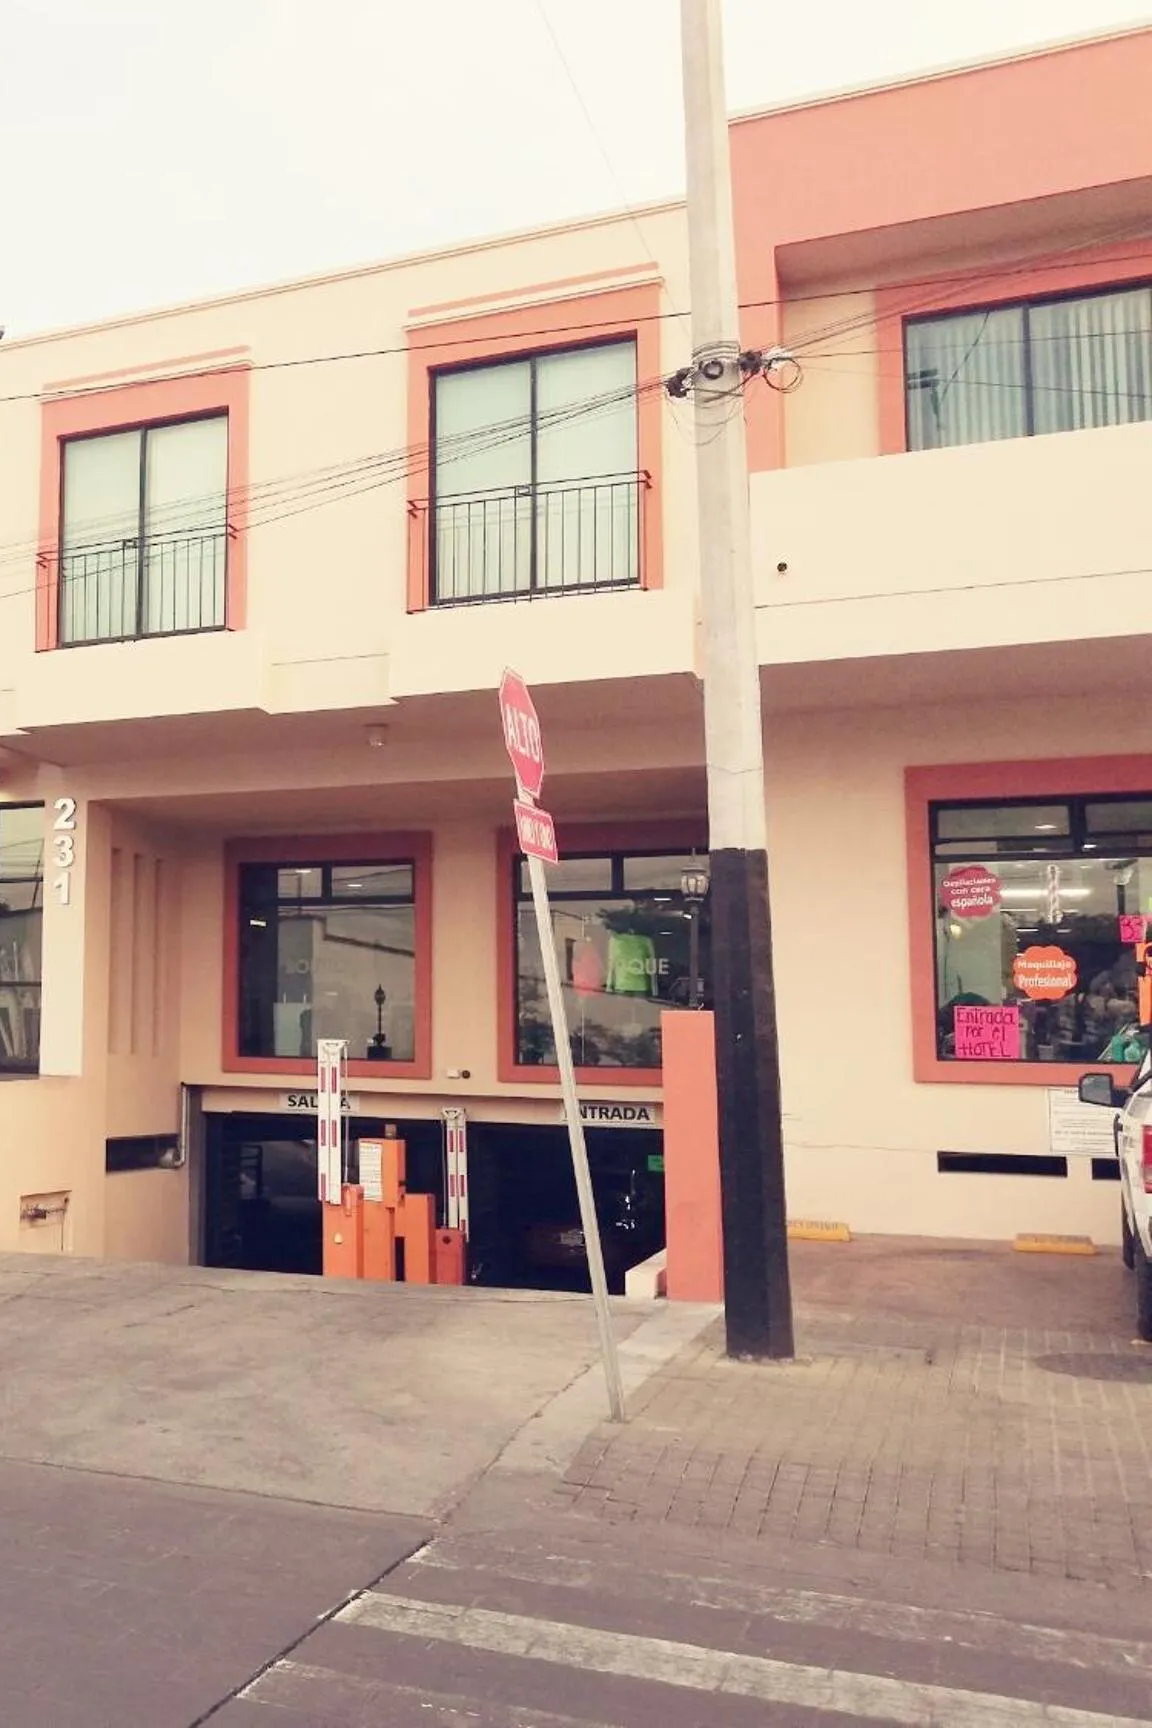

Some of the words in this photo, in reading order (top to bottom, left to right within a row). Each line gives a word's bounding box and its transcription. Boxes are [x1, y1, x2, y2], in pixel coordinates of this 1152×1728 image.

[505, 703, 540, 763] ALTO
[52, 797, 77, 906] 231
[950, 893, 993, 909] española
[1018, 960, 1072, 971] Maquillaje
[1019, 973, 1073, 988] Profesional
[956, 1007, 1016, 1025] Entrada
[958, 1041, 1012, 1058] HOTEL
[288, 1094, 351, 1109] SALA
[579, 1105, 651, 1122] NTRADA
